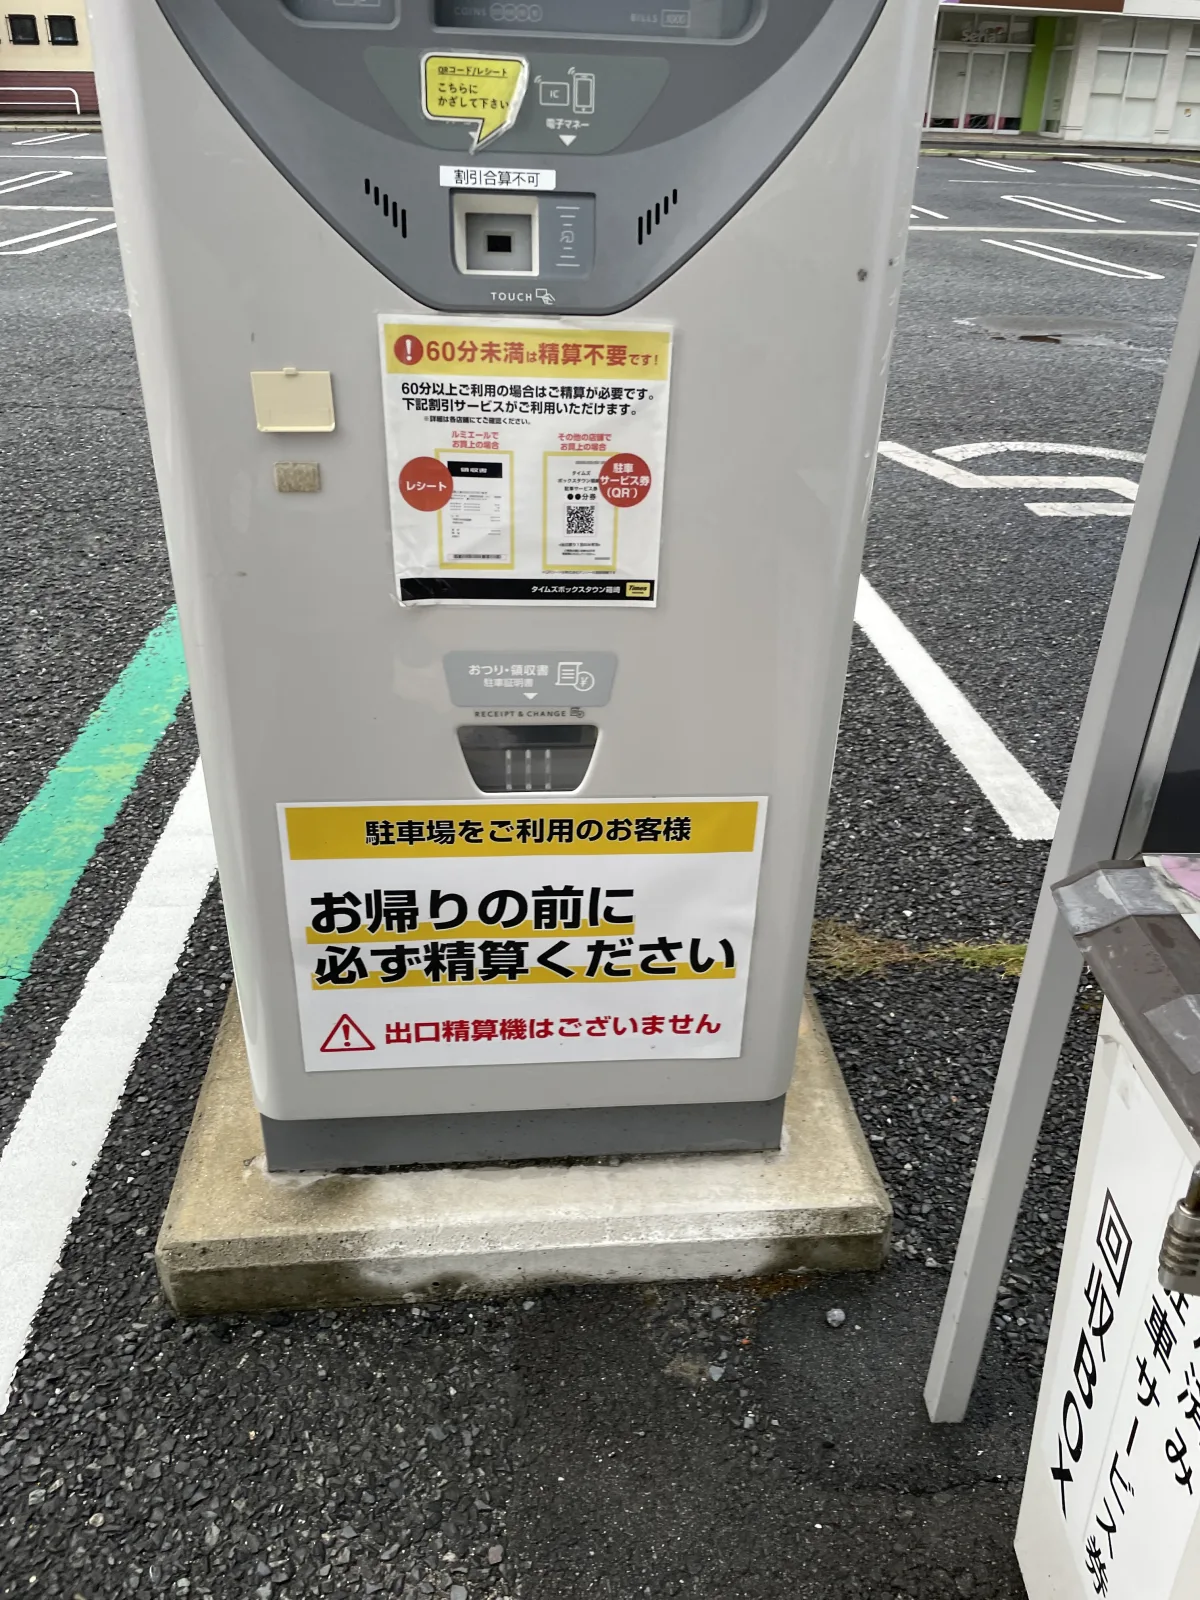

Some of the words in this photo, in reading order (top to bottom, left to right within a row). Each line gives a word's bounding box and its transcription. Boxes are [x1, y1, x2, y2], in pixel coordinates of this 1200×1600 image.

[437, 66, 507, 76] QRコード/レシート
[438, 82, 478, 94] こちらに
[550, 90, 560, 99] IC
[438, 97, 509, 110] かざして下さい
[546, 118, 590, 130] 電子マネー
[454, 169, 541, 188] 割引合算不可
[490, 291, 533, 302] TOUCH
[401, 382, 654, 400] 60分以上ご利用の場合はご精算が必要です。
[402, 397, 637, 415] 下記割引サービスがご利用いただけます。
[451, 430, 499, 440] ルミエールで
[558, 433, 612, 442] その他の店舗で
[452, 440, 500, 450] お買上の場合
[560, 443, 607, 451] お買上の場合
[612, 463, 634, 474] 駐車
[406, 480, 447, 492] レシート
[600, 475, 650, 487] サービス券
[531, 585, 621, 594] タイムズボックスタウン箱崎
[468, 664, 549, 676] おつり・領収書
[483, 678, 534, 688] 駐車証明書
[474, 710, 515, 718] RECEIPT
[517, 710, 524, 718] &
[526, 710, 566, 718] CHANGE
[364, 816, 692, 847] 駐車場をご利用のお客様
[310, 885, 635, 935] お帰りの前に
[313, 936, 736, 986] 必ず精算ください
[384, 1013, 722, 1046] 出口精算機はございません
[1050, 1187, 1132, 1519] 回収BOX
[1085, 1288, 1190, 1598] 車サービス券
